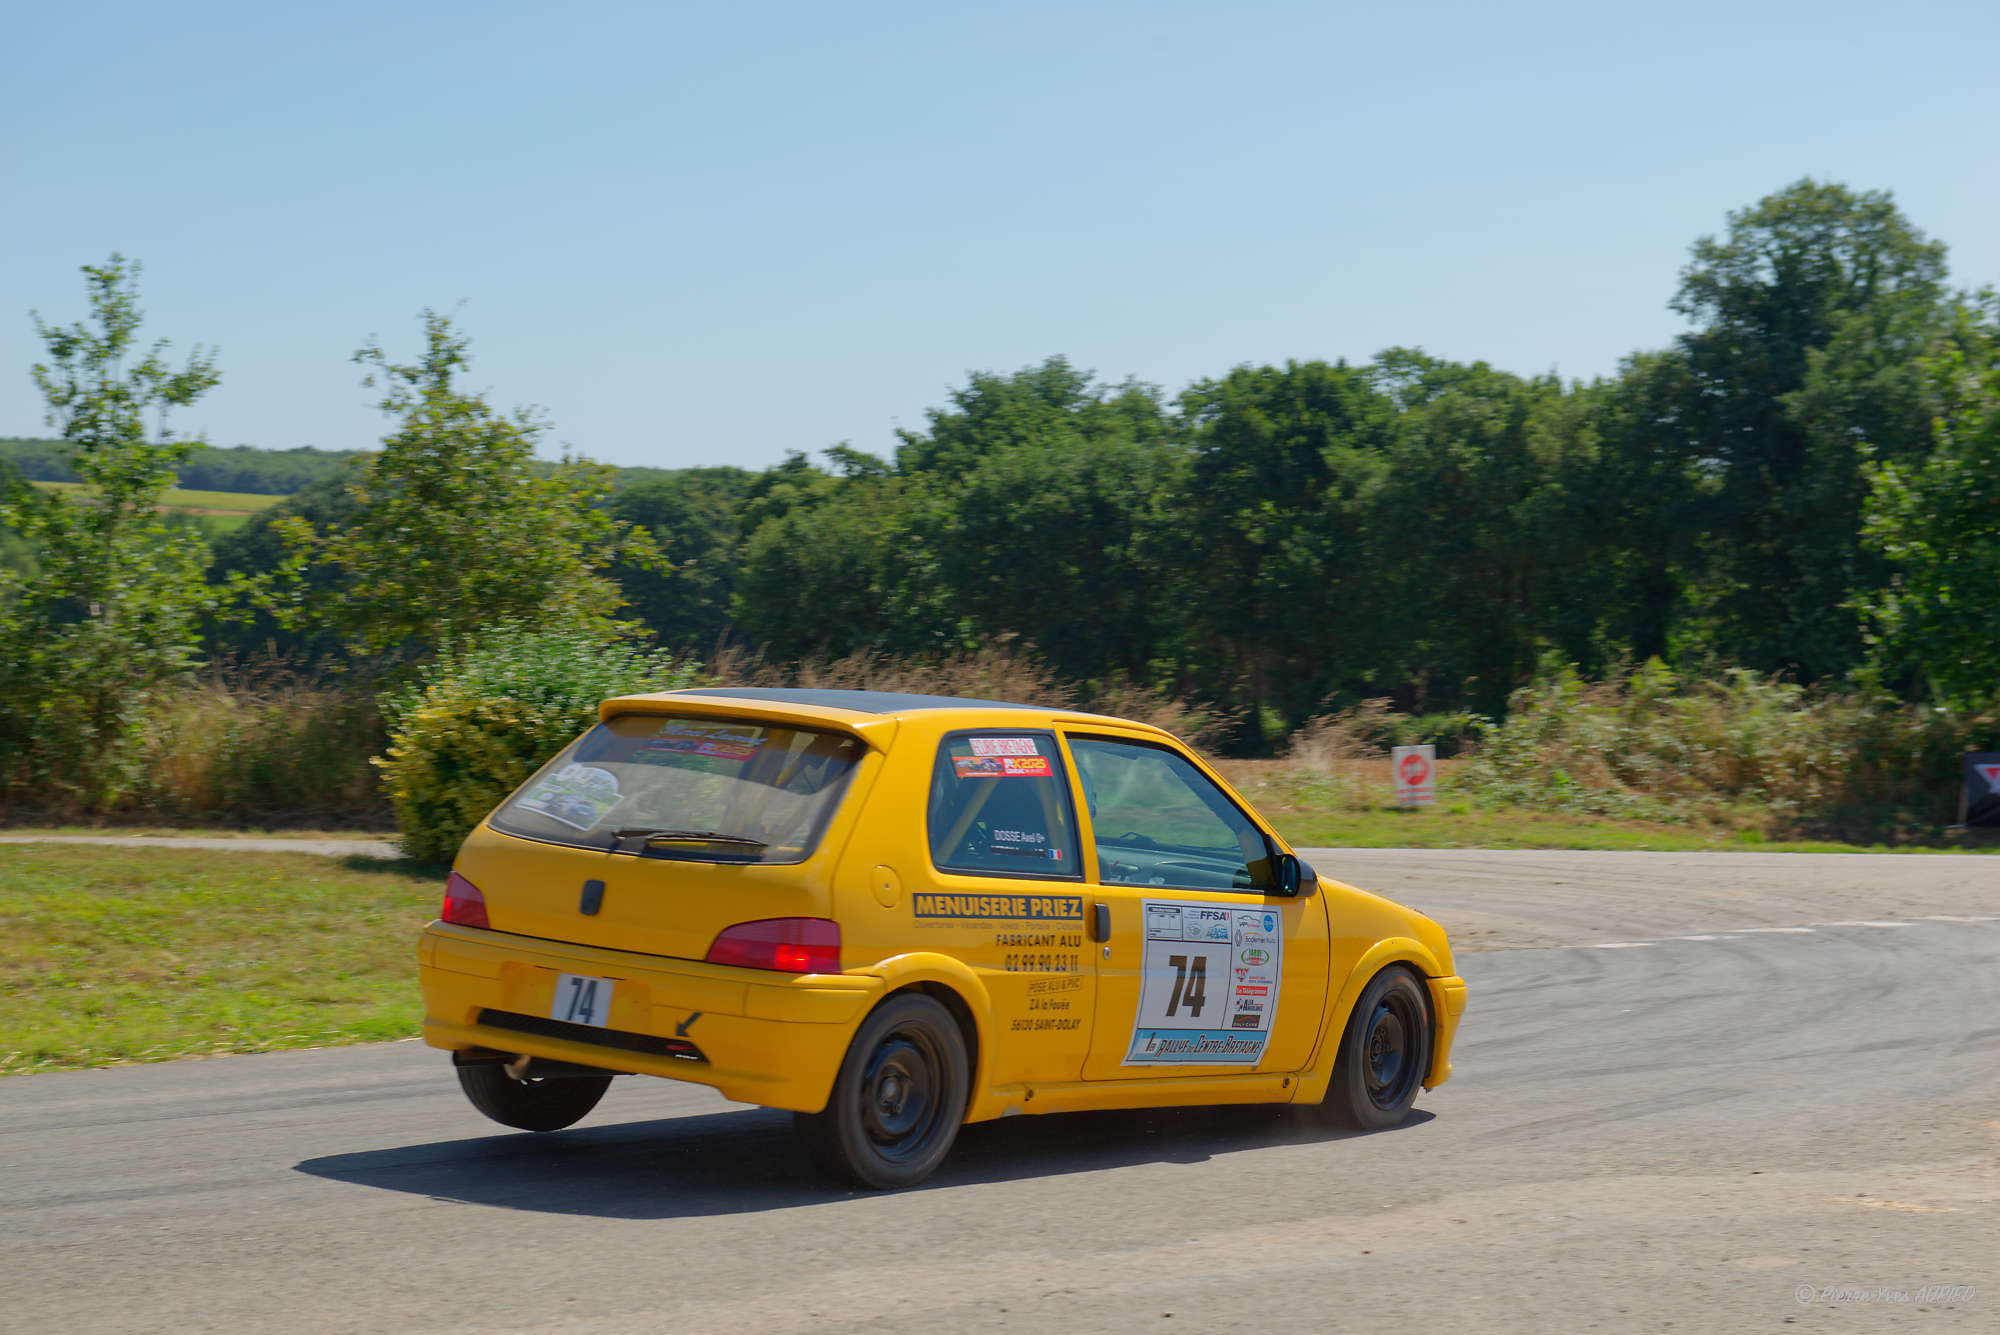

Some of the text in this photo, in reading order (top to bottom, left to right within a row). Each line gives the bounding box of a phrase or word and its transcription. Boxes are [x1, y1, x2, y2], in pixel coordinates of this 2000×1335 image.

[916, 895, 1081, 917] MENUISERIE PRIEZ
[1200, 910, 1226, 921] FFSA
[996, 934, 1081, 948] FABRICANT ALU
[1005, 954, 1019, 972] 02
[1022, 954, 1036, 972] 99
[1054, 954, 1068, 972] 23
[1166, 955, 1207, 1018] 74
[566, 977, 599, 1024] 74
